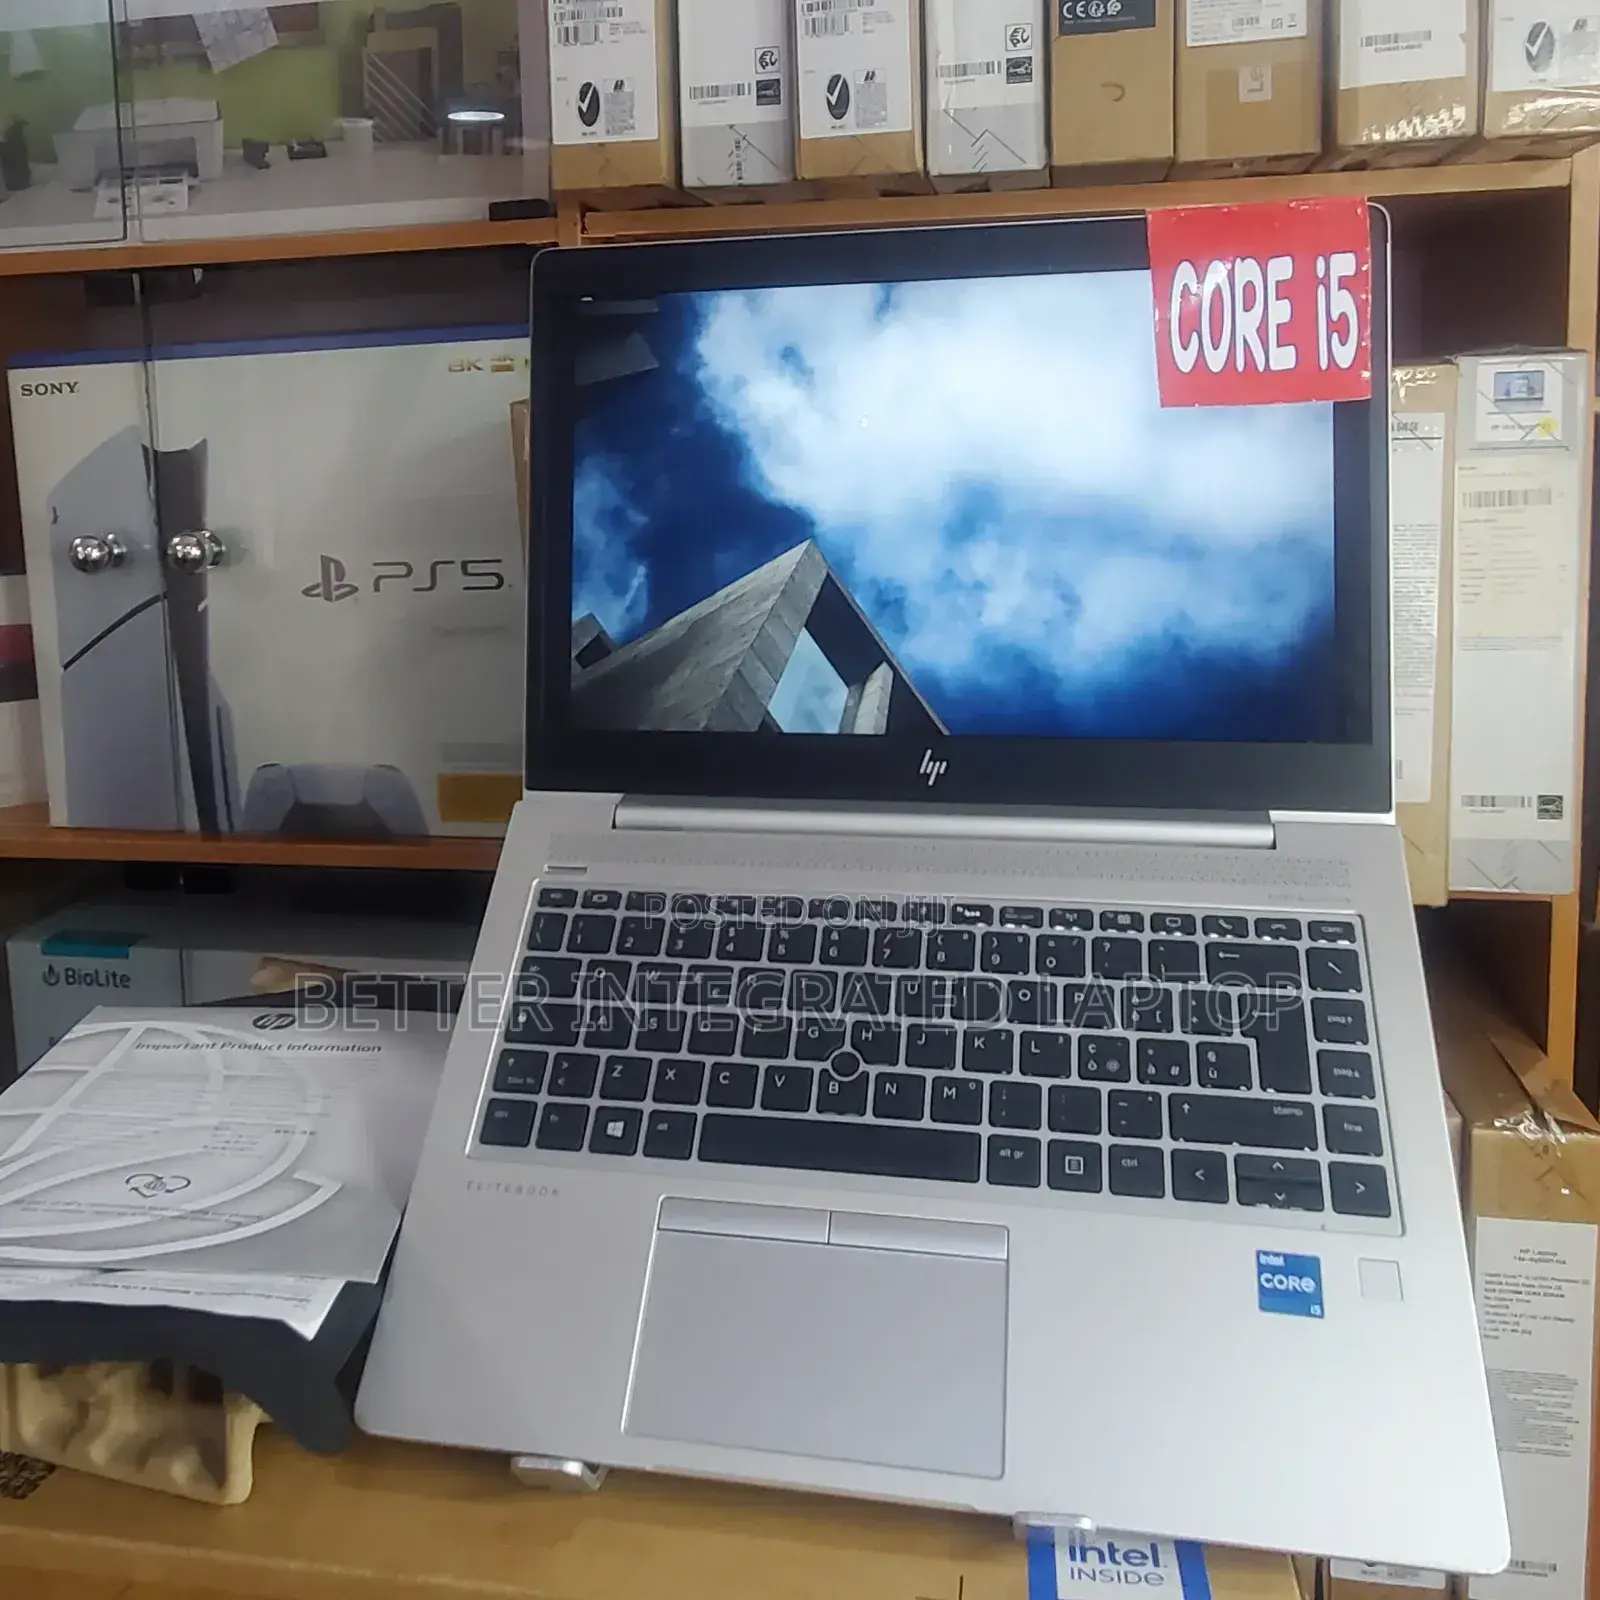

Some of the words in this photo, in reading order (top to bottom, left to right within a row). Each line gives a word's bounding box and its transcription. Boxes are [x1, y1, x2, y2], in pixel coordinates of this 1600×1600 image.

[1170, 255, 1297, 374] CORE
[1316, 252, 1359, 371] i5
[20, 381, 79, 397] SONY
[372, 558, 505, 592] PS5
[624, 937, 634, 948] 2
[725, 942, 735, 952] 4
[829, 946, 839, 957] 6
[882, 949, 892, 959] 7
[991, 953, 1001, 965] 9
[64, 967, 132, 989] BioLite
[907, 982, 919, 995] U
[1018, 989, 1031, 1001] O
[1073, 991, 1085, 1004] P
[648, 1016, 658, 1030] S
[807, 1025, 819, 1038] G
[861, 1028, 873, 1041] H
[917, 1033, 926, 1045] J
[974, 1036, 985, 1049] K
[134, 1041, 218, 1052] Important
[220, 1041, 283, 1052] Product
[286, 1042, 382, 1053] Information
[1031, 1040, 1041, 1053] L
[611, 1065, 624, 1078] Z
[665, 1068, 677, 1081] X
[719, 1072, 731, 1084] C
[774, 1074, 787, 1088] V
[828, 1080, 840, 1094] B
[885, 1082, 898, 1096] N
[943, 1086, 957, 1099] M
